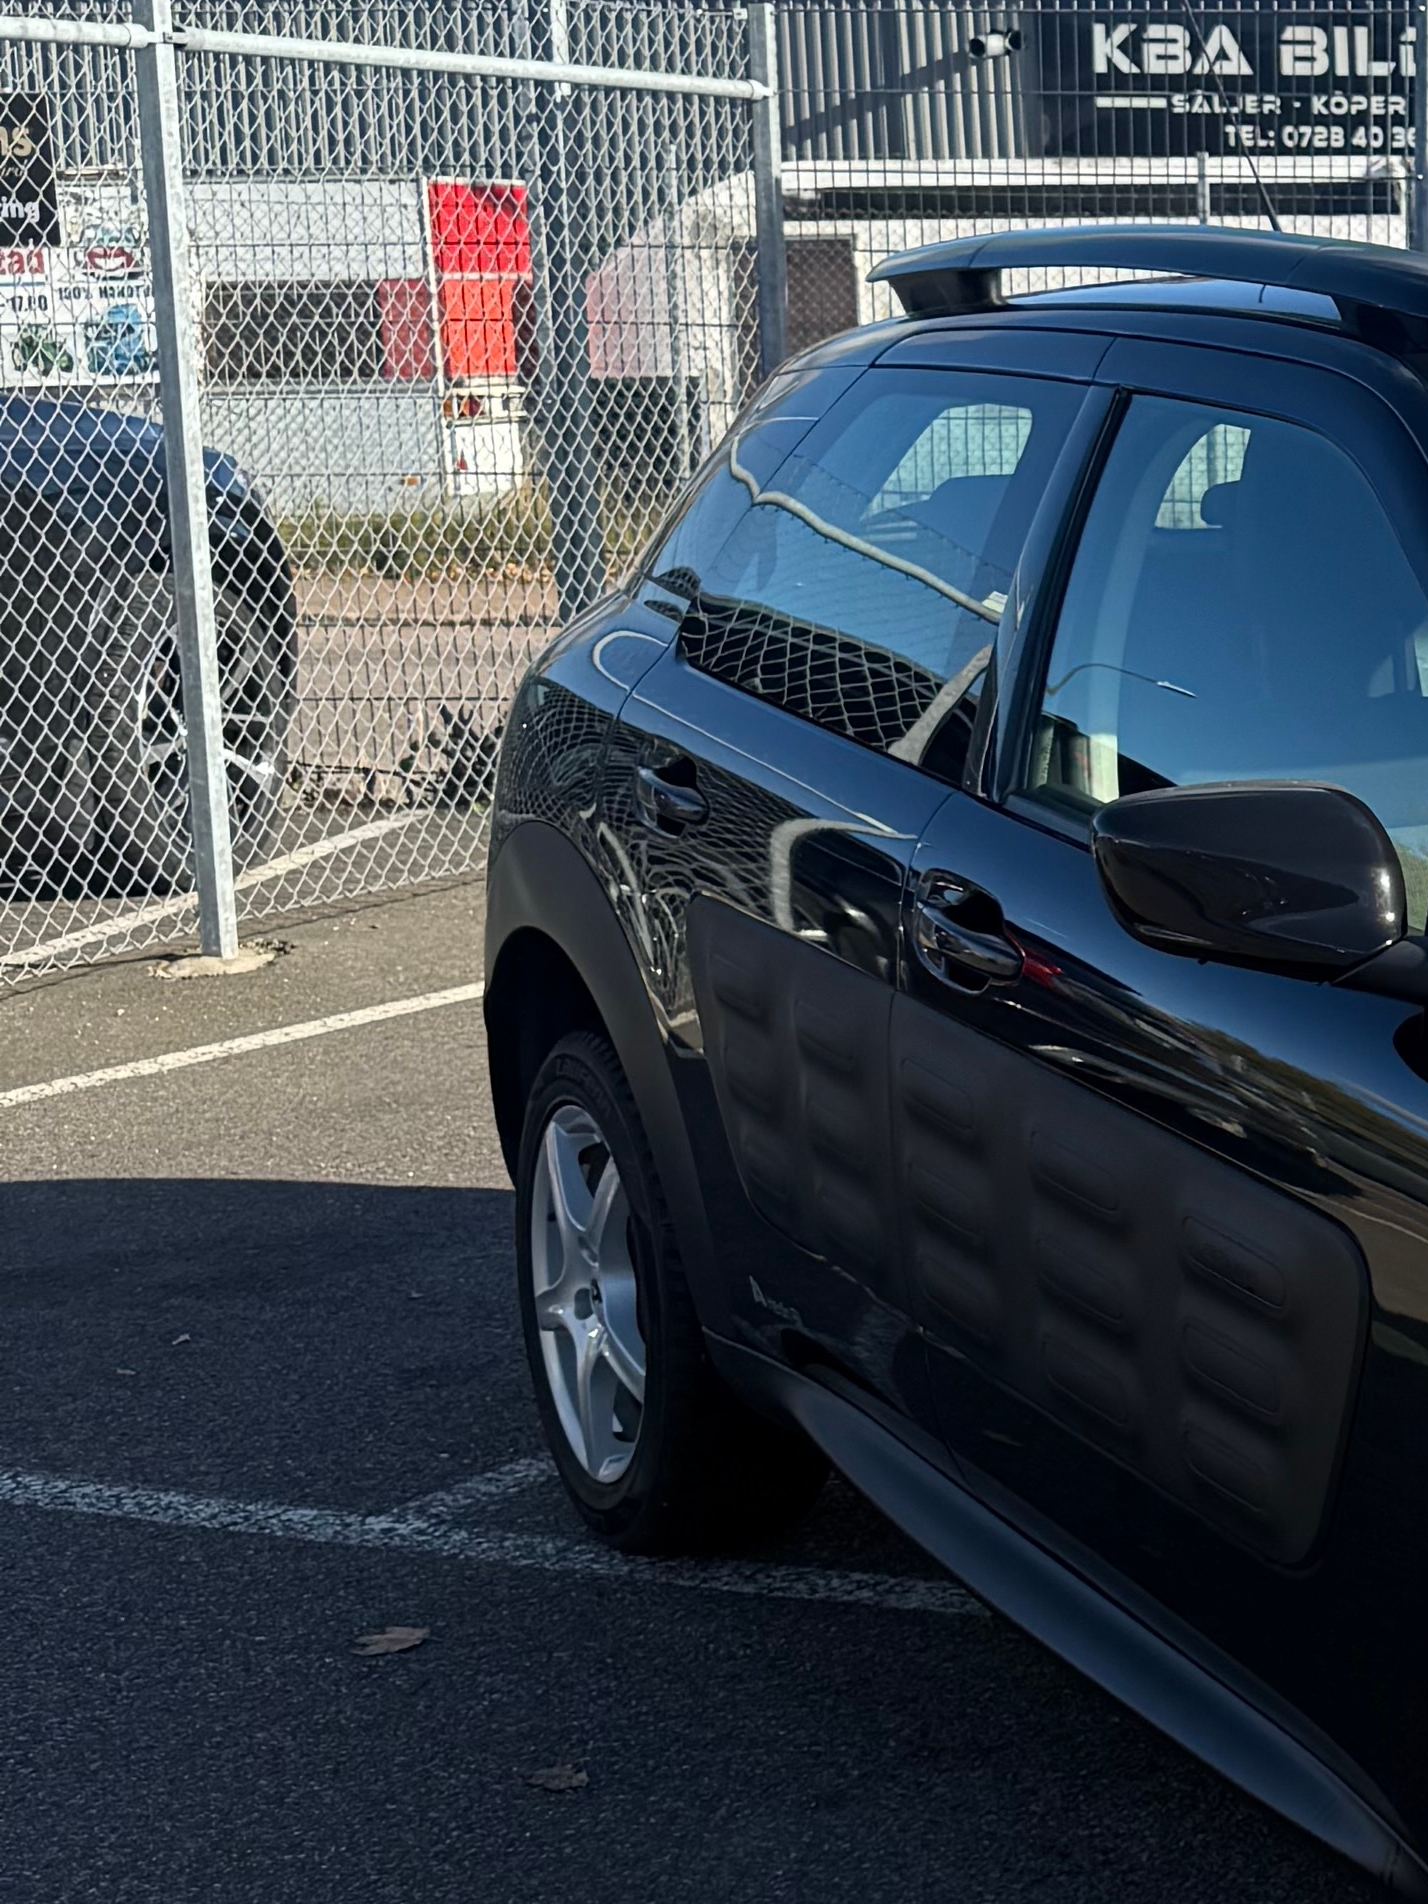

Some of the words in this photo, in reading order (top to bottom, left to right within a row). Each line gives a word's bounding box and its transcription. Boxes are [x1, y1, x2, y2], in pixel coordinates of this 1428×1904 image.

[1092, 23, 1254, 77] KBA
[1171, 89, 1281, 114] SÄLJER
[1312, 90, 1407, 116] KÖPER
[1225, 124, 1276, 148] TEL:
[1282, 125, 1345, 148] 0728
[1352, 126, 1385, 149] 40
